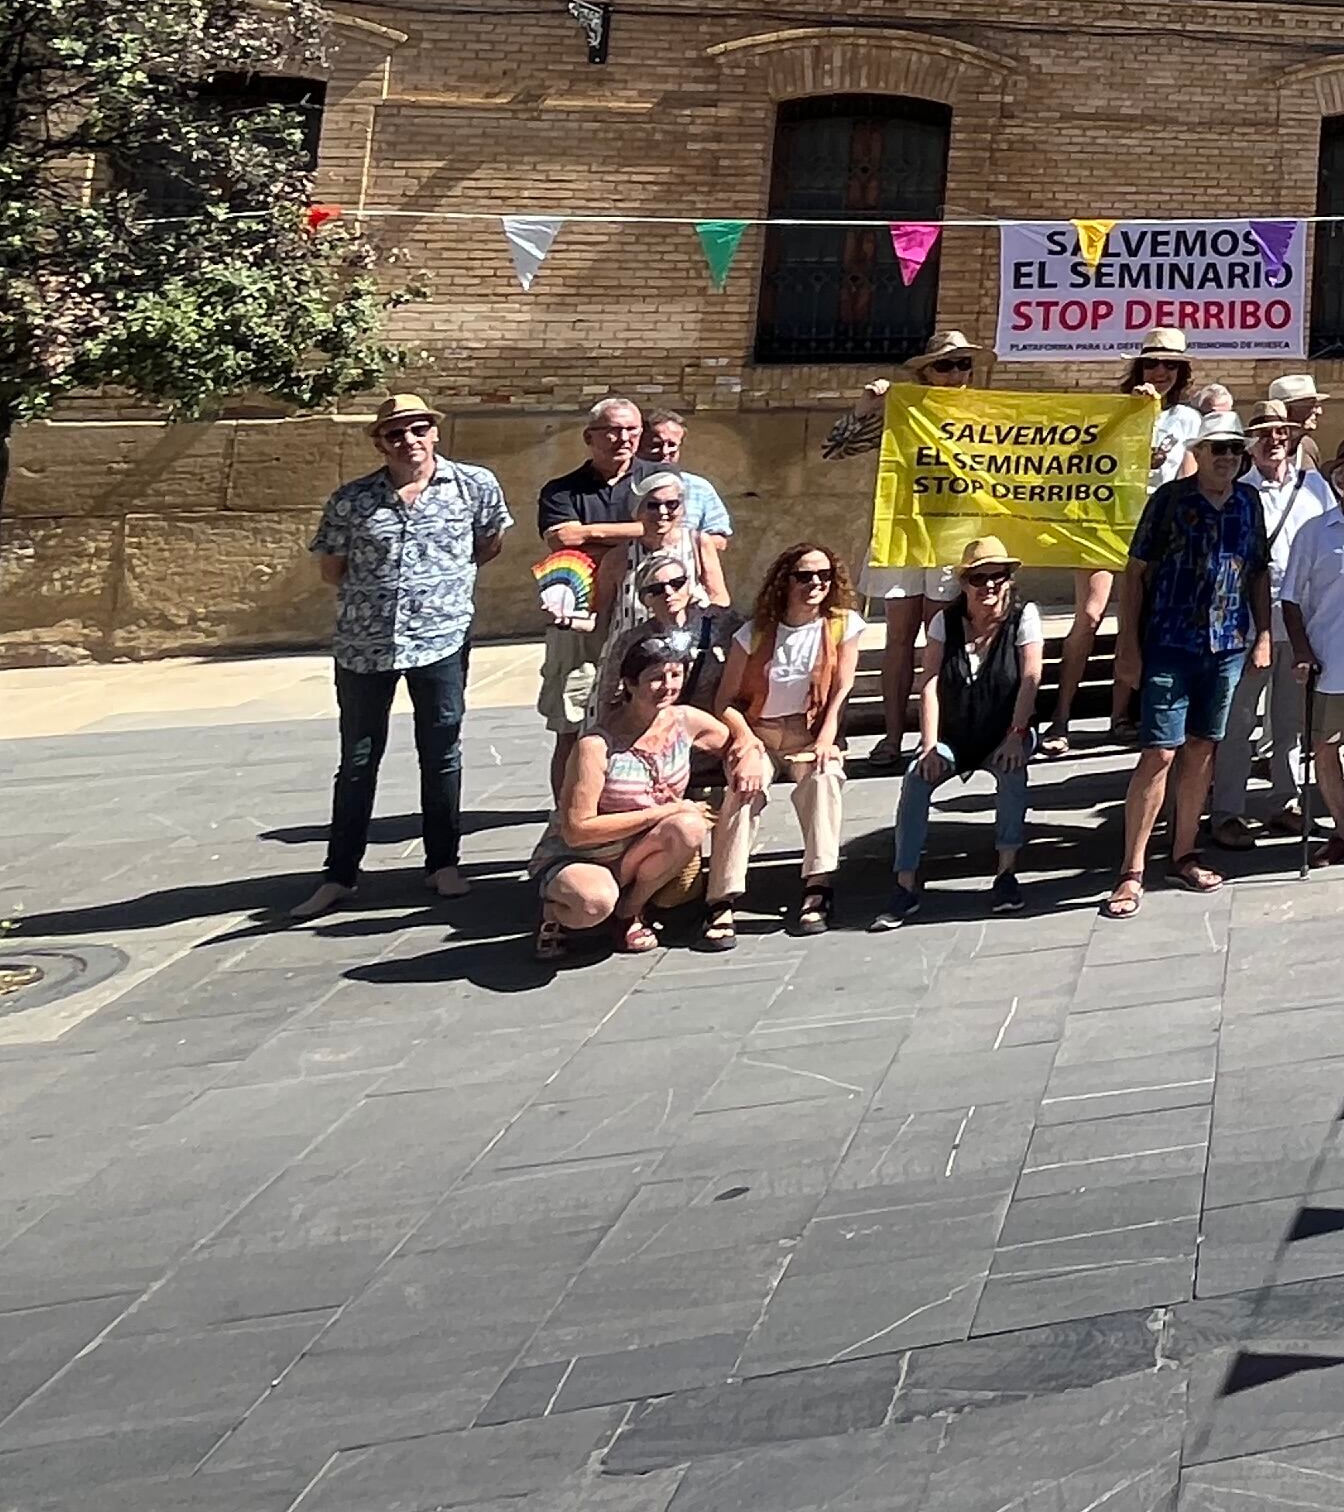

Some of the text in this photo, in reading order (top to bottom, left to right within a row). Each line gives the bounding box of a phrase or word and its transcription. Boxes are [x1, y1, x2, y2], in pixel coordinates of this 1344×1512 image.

[1013, 261, 1293, 289] EL SEMINARIO
[1011, 299, 1292, 331] STOP DERRIBO
[938, 422, 1099, 445] SALVEMOS
[916, 446, 1118, 476] EL SEMINARIO
[913, 476, 1114, 502] STOP DERRIBO
